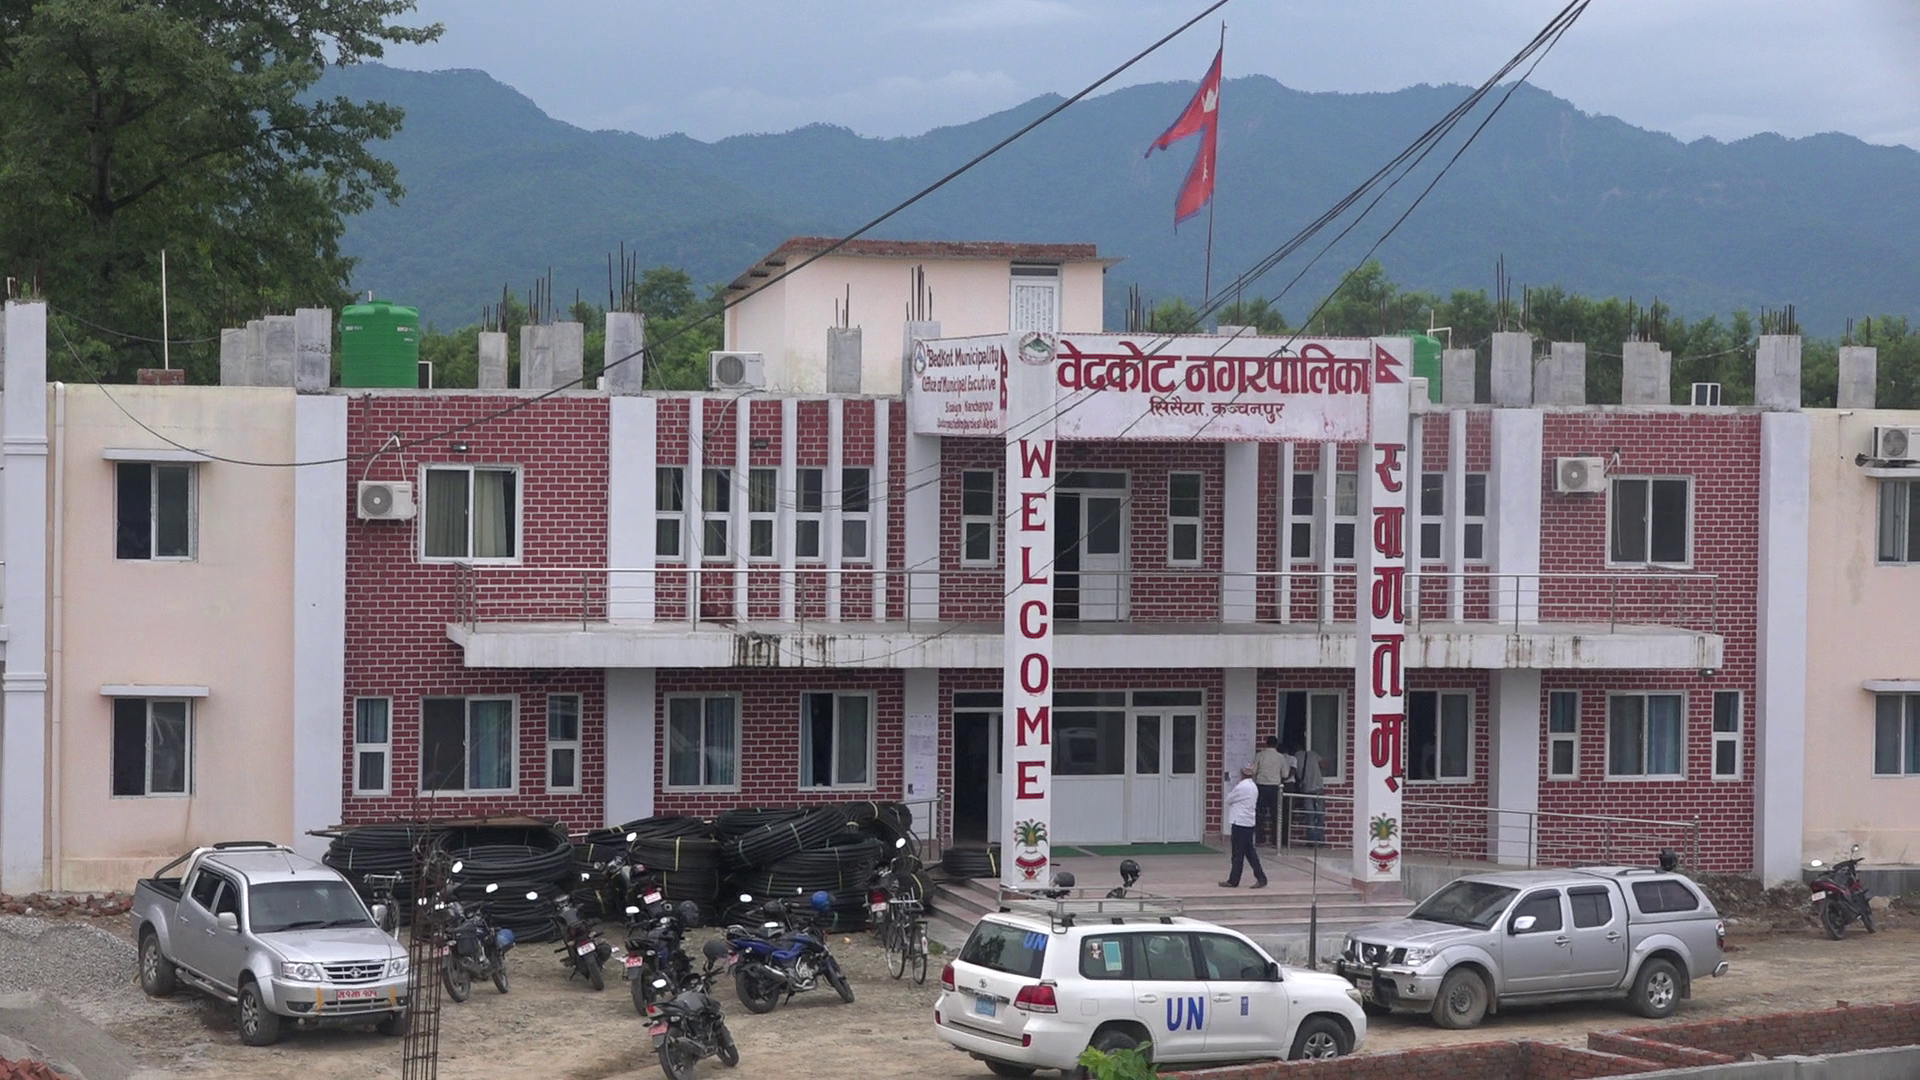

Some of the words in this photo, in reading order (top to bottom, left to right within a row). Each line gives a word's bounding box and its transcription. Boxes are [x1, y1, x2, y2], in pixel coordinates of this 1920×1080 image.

[954, 345, 999, 371] Municipality
[1186, 343, 1371, 395] नगरपालिका
[1016, 440, 1054, 800] WELCOME
[1370, 443, 1406, 793] स्वागतम्
[1023, 932, 1049, 951] UN
[1166, 996, 1204, 1031] UN
